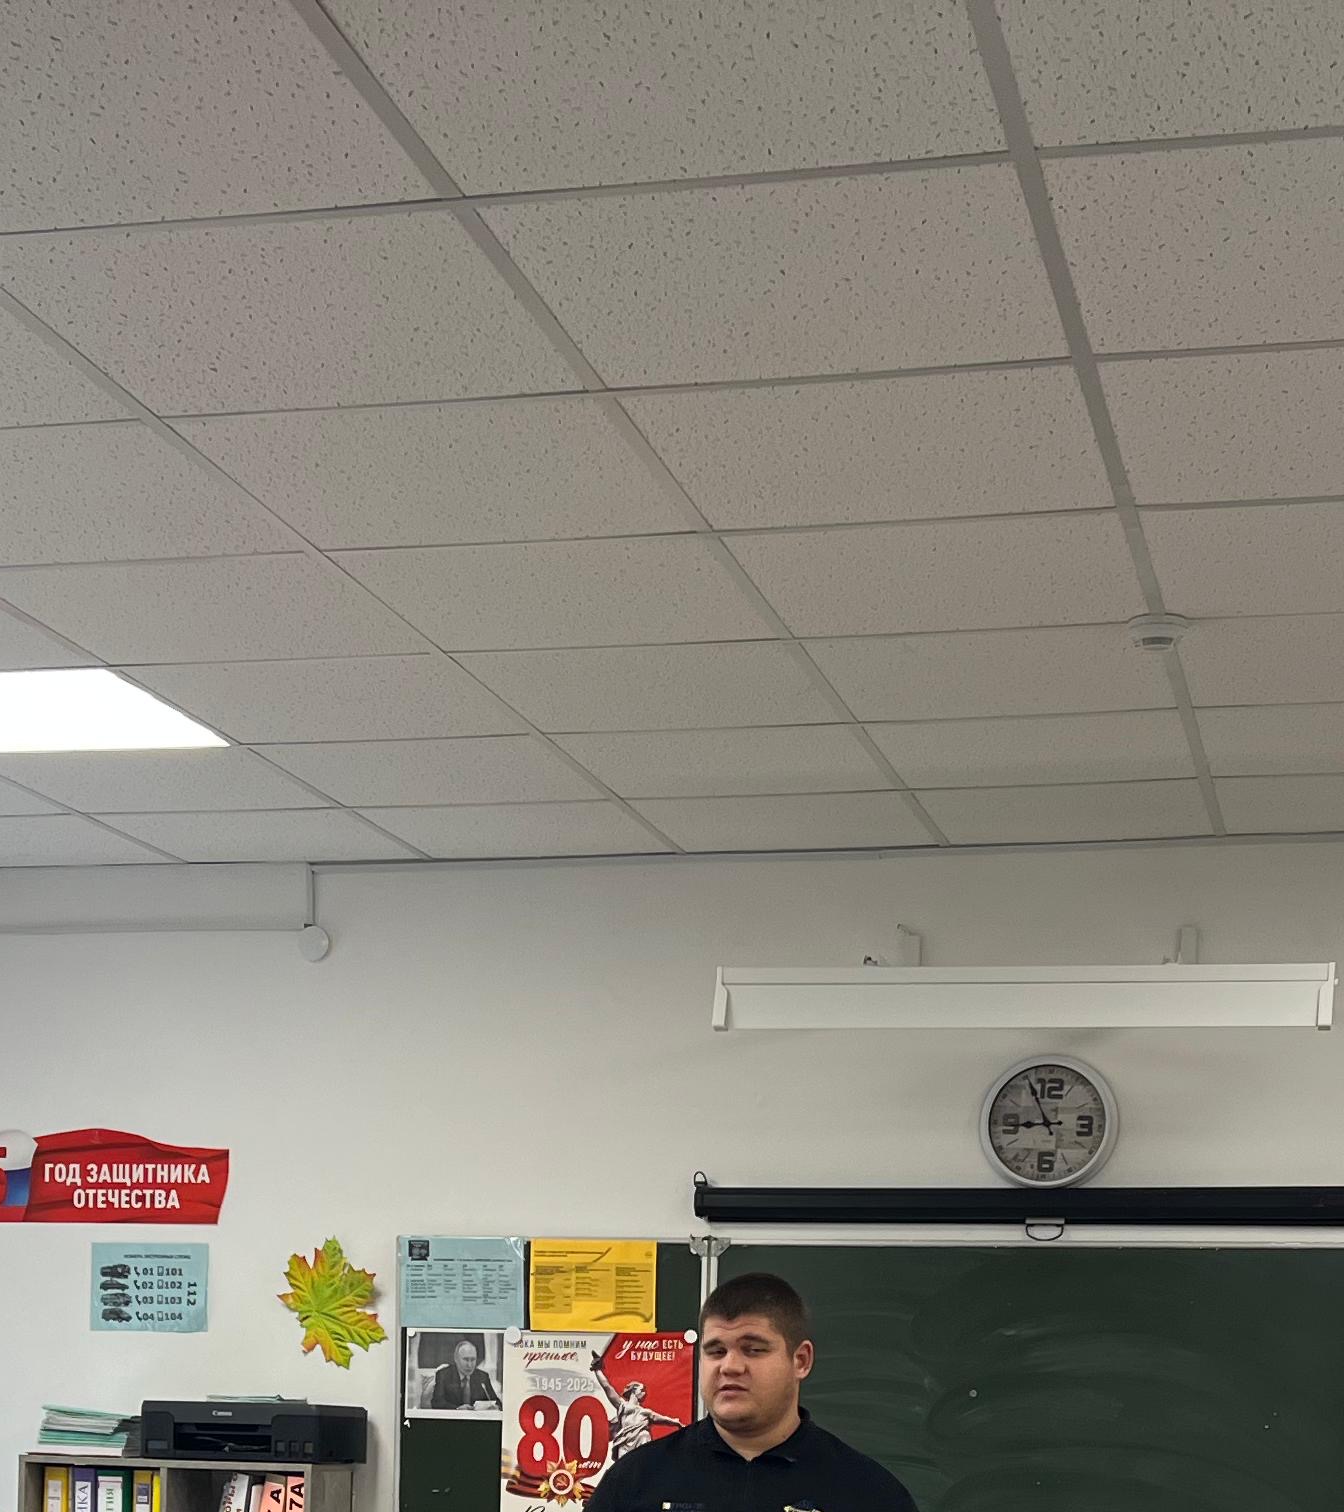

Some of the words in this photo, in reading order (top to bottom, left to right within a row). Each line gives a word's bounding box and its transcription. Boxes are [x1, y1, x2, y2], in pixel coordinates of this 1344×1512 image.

[1037, 1078, 1064, 1100] 12
[1002, 1113, 1019, 1135] 9
[1076, 1115, 1093, 1137] 3
[1037, 1151, 1055, 1173] 6
[43, 1164, 82, 1186] ГОД
[86, 1163, 211, 1187] ЗАЩИТНИКА
[72, 1188, 181, 1210] ОТЕЧЕСТВА
[142, 1268, 154, 1276] 01
[165, 1268, 183, 1276] 101
[141, 1281, 154, 1289] 02
[164, 1281, 183, 1289] 102
[187, 1281, 197, 1307] 112
[142, 1296, 154, 1304] 03
[164, 1296, 182, 1304] 103
[514, 1340, 535, 1349] ОКА
[537, 1340, 551, 1349] МЫ
[553, 1340, 587, 1349] ПОМНИМ
[662, 1340, 684, 1350] ЕСТЬ
[630, 1351, 676, 1362] БУДУЩЕЕ!
[535, 1377, 595, 1392] 1945-2025
[517, 1394, 610, 1479] 80
[270, 1488, 282, 1504] А
